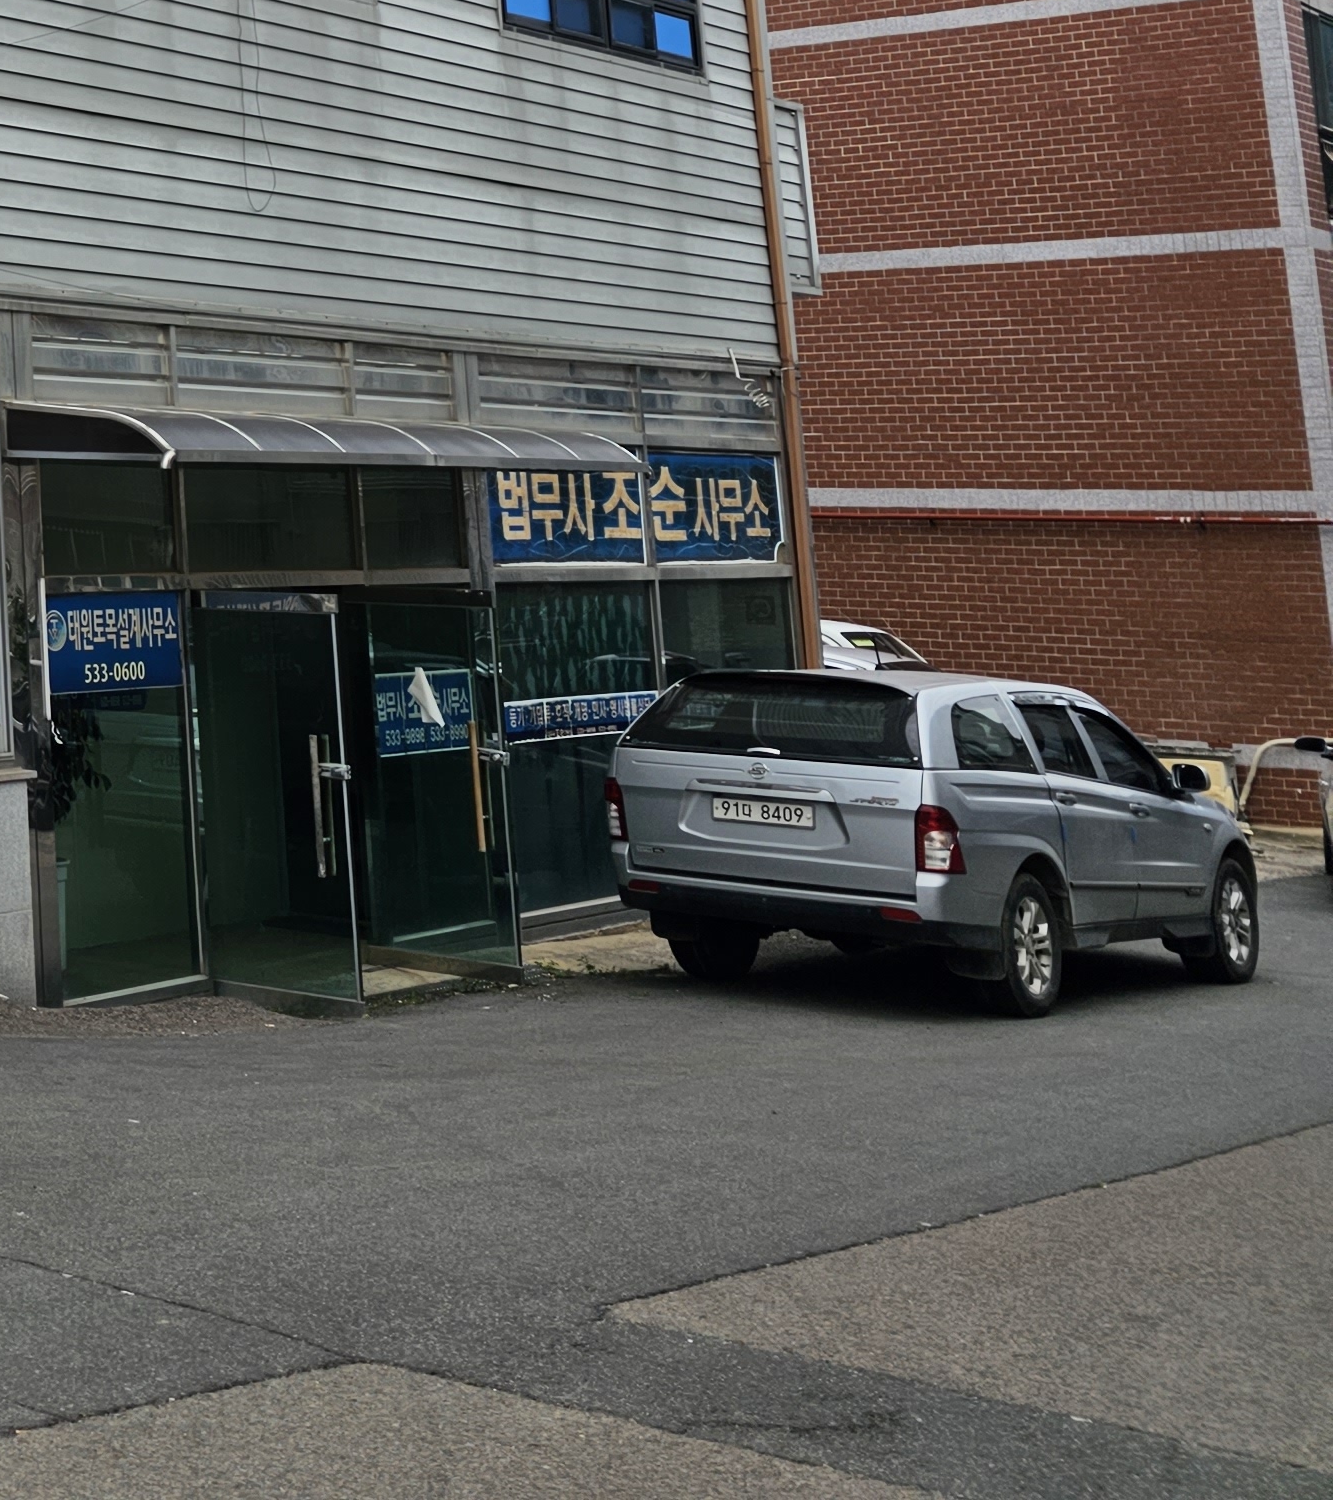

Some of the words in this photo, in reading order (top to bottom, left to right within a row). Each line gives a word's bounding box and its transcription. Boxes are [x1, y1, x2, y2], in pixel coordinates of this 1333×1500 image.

[66, 606, 178, 651] 태원토목설계사무소
[84, 660, 146, 684] 533-0600
[385, 727, 426, 747] 533-9898
[760, 804, 805, 824] 8409
